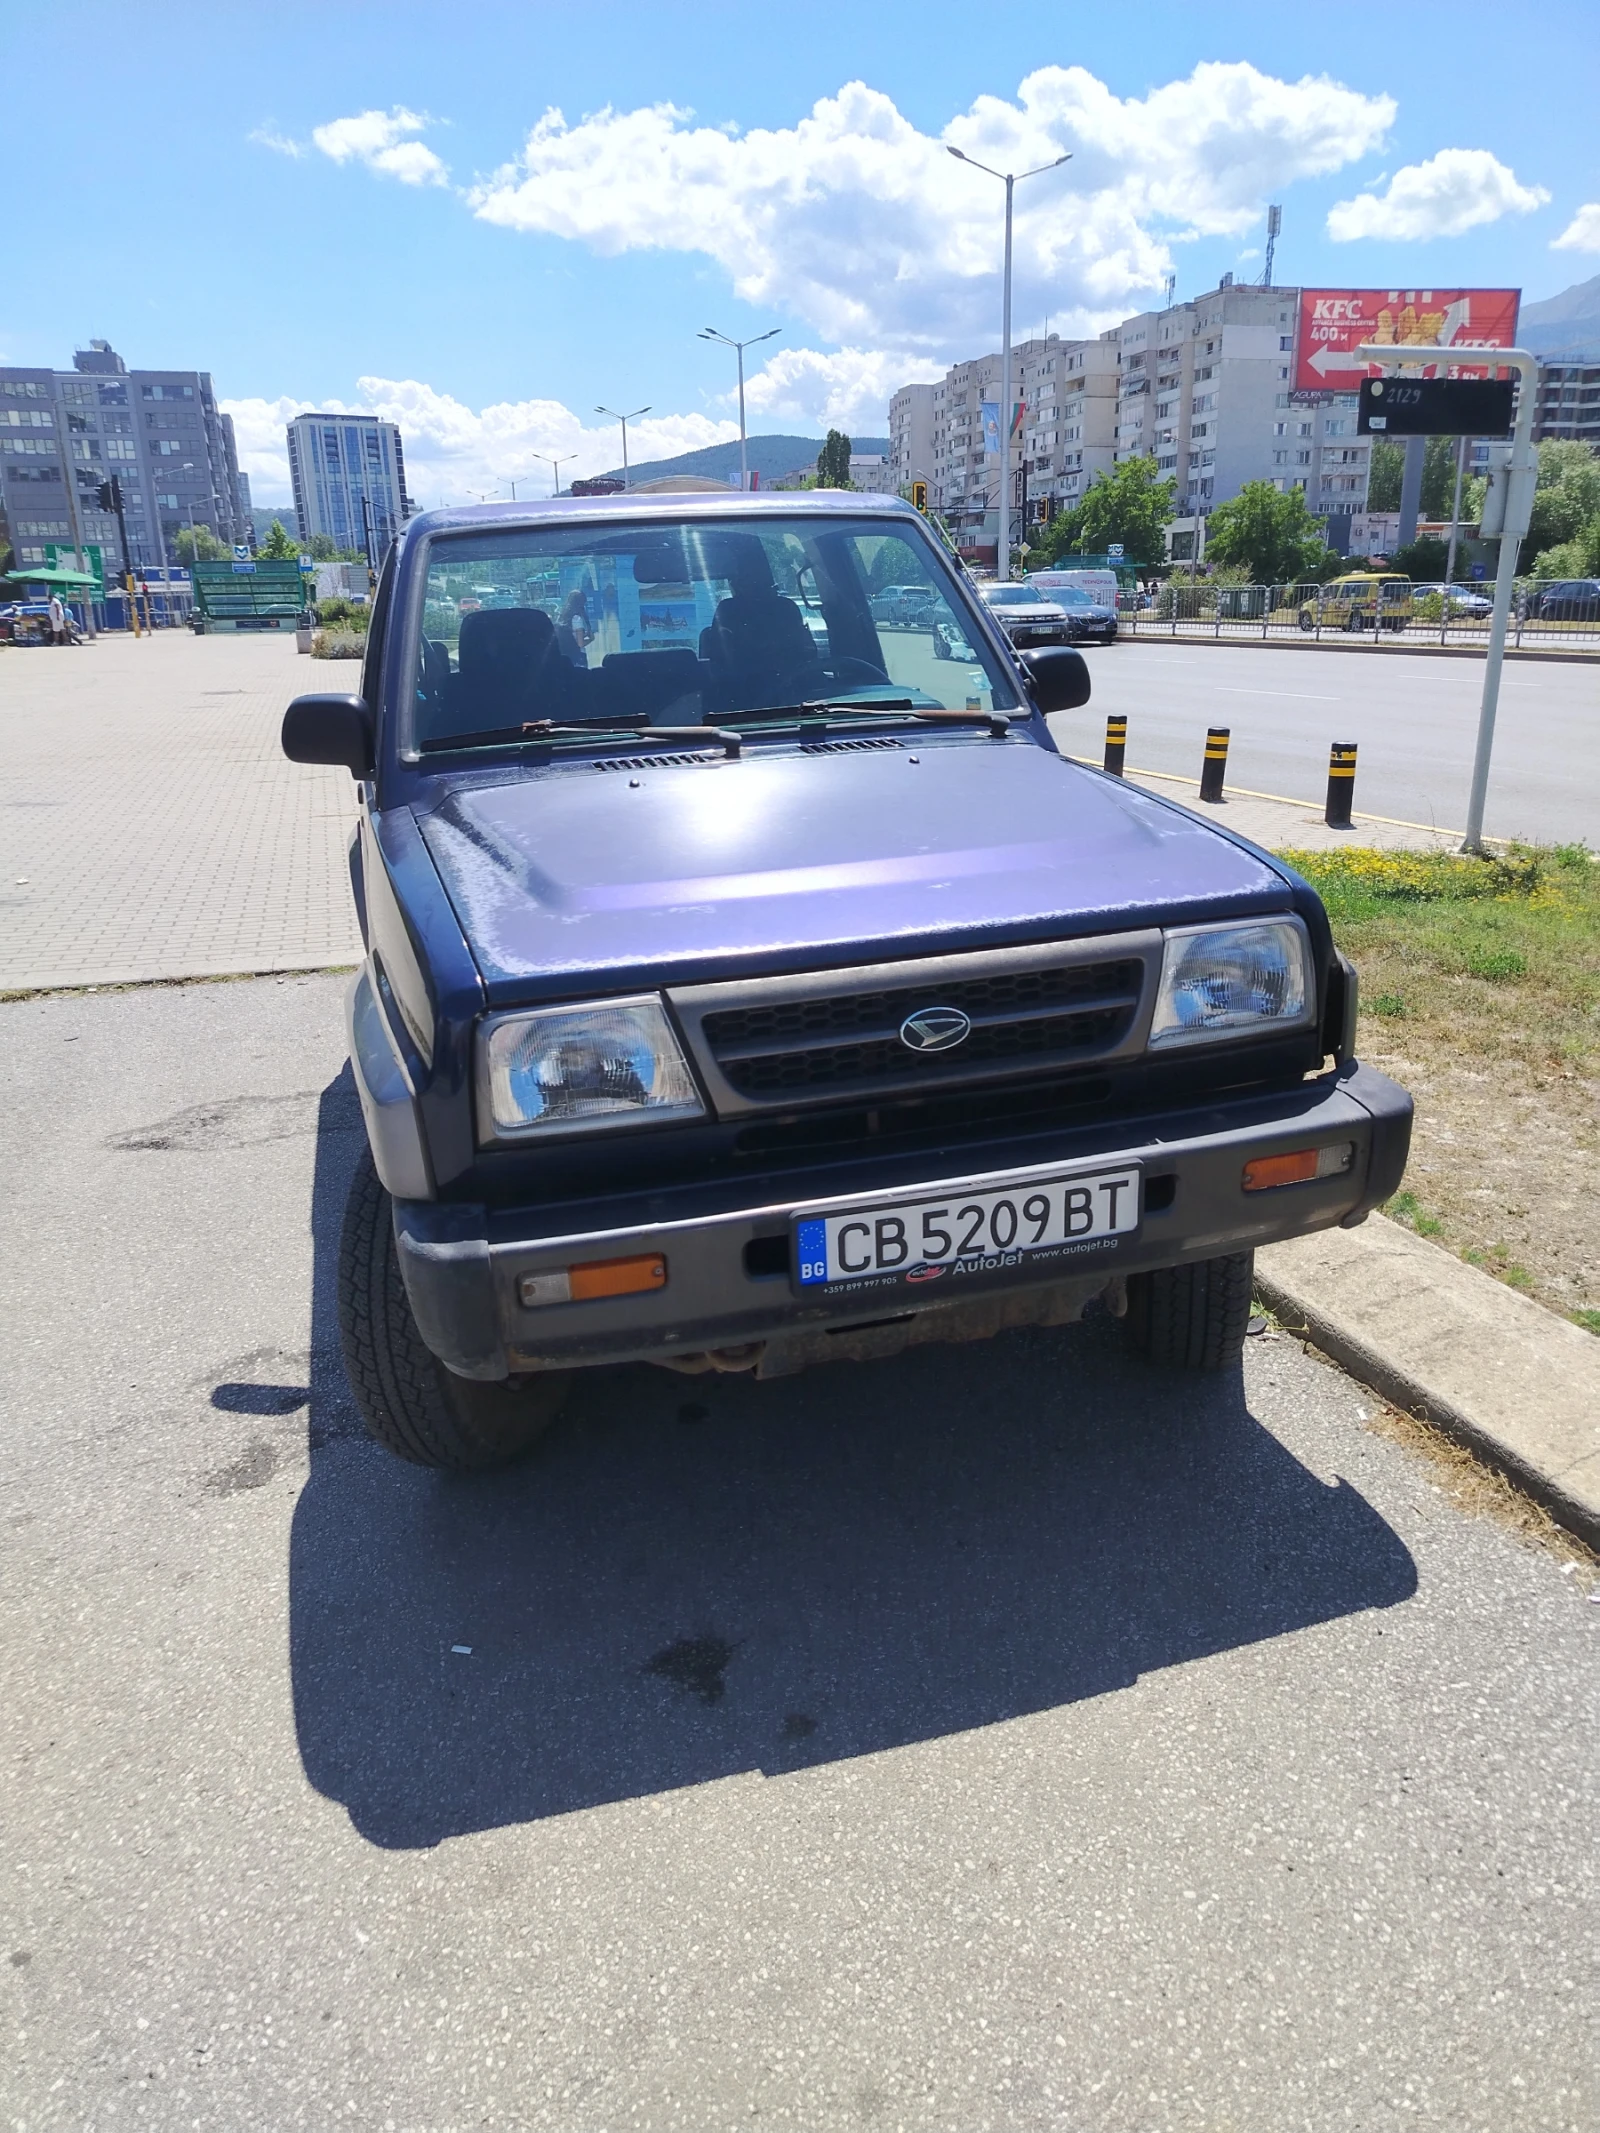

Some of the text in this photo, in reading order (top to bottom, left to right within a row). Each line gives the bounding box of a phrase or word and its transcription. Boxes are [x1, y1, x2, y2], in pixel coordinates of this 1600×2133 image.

[1311, 299, 1363, 319] KFC
[1310, 326, 1339, 341] 400
[1031, 1238, 1119, 1261] www.autojet.bg
[801, 1261, 826, 1279] BG
[952, 1249, 1025, 1276] AutoJet
[823, 1276, 897, 1294] +359 899 997 905
